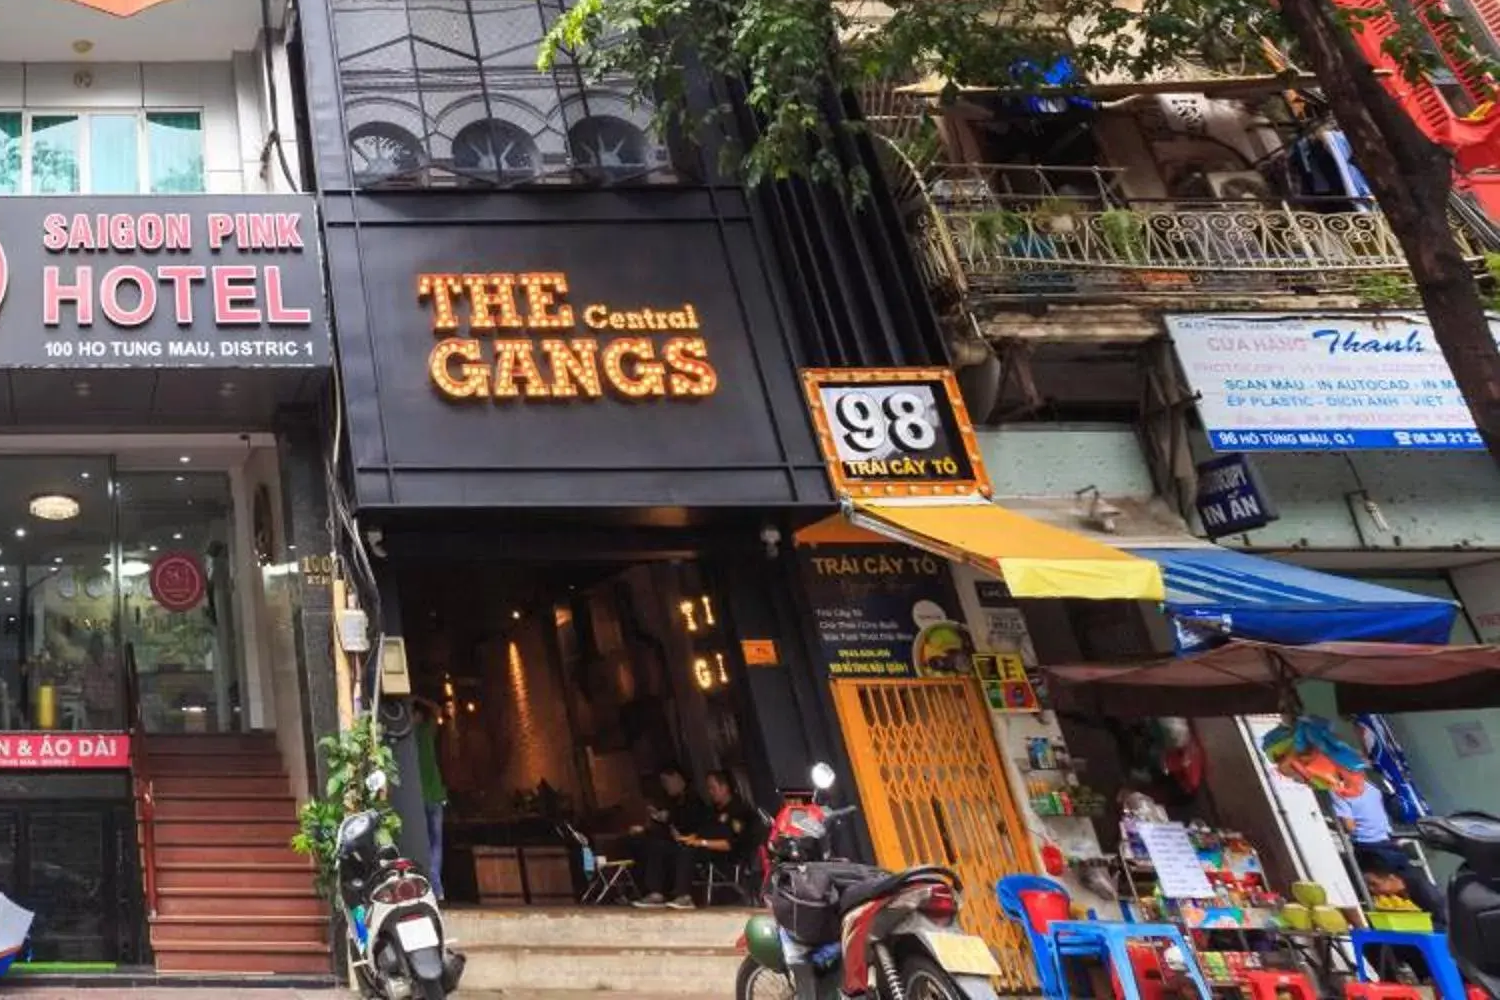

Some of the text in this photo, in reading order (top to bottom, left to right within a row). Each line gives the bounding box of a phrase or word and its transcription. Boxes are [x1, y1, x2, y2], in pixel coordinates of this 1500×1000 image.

[43, 213, 304, 252] SAIGON PINK
[43, 265, 312, 327] HOTEL
[417, 271, 699, 332] THE Central
[44, 341, 314, 359] 100 HO TUNG MAU, DISTRIC 1
[427, 336, 718, 399] GANGS
[1224, 378, 1267, 391] SCAN
[1337, 379, 1409, 391] AUTOCAD
[835, 391, 937, 452] 98
[890, 457, 927, 475] CÂY
[18, 738, 33, 757] &
